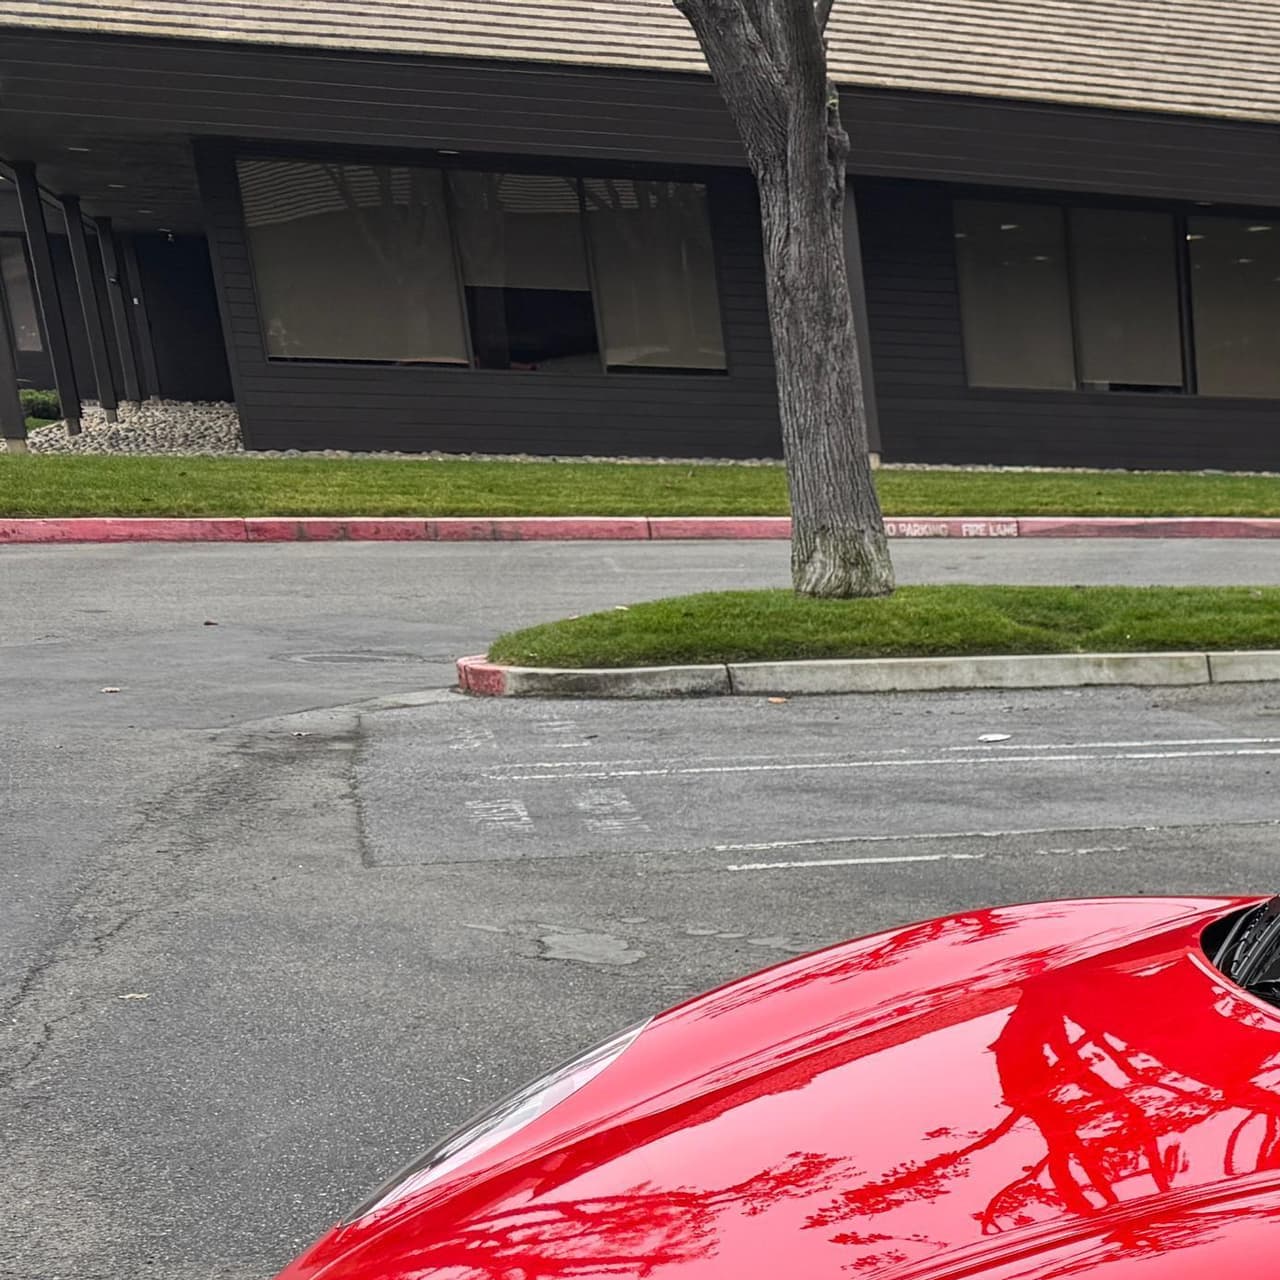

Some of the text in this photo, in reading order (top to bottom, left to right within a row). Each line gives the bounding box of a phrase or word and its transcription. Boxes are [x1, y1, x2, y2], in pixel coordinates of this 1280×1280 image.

[899, 523, 949, 536] PARKING
[963, 523, 986, 536] FIRE
[989, 523, 1018, 536] LANE
